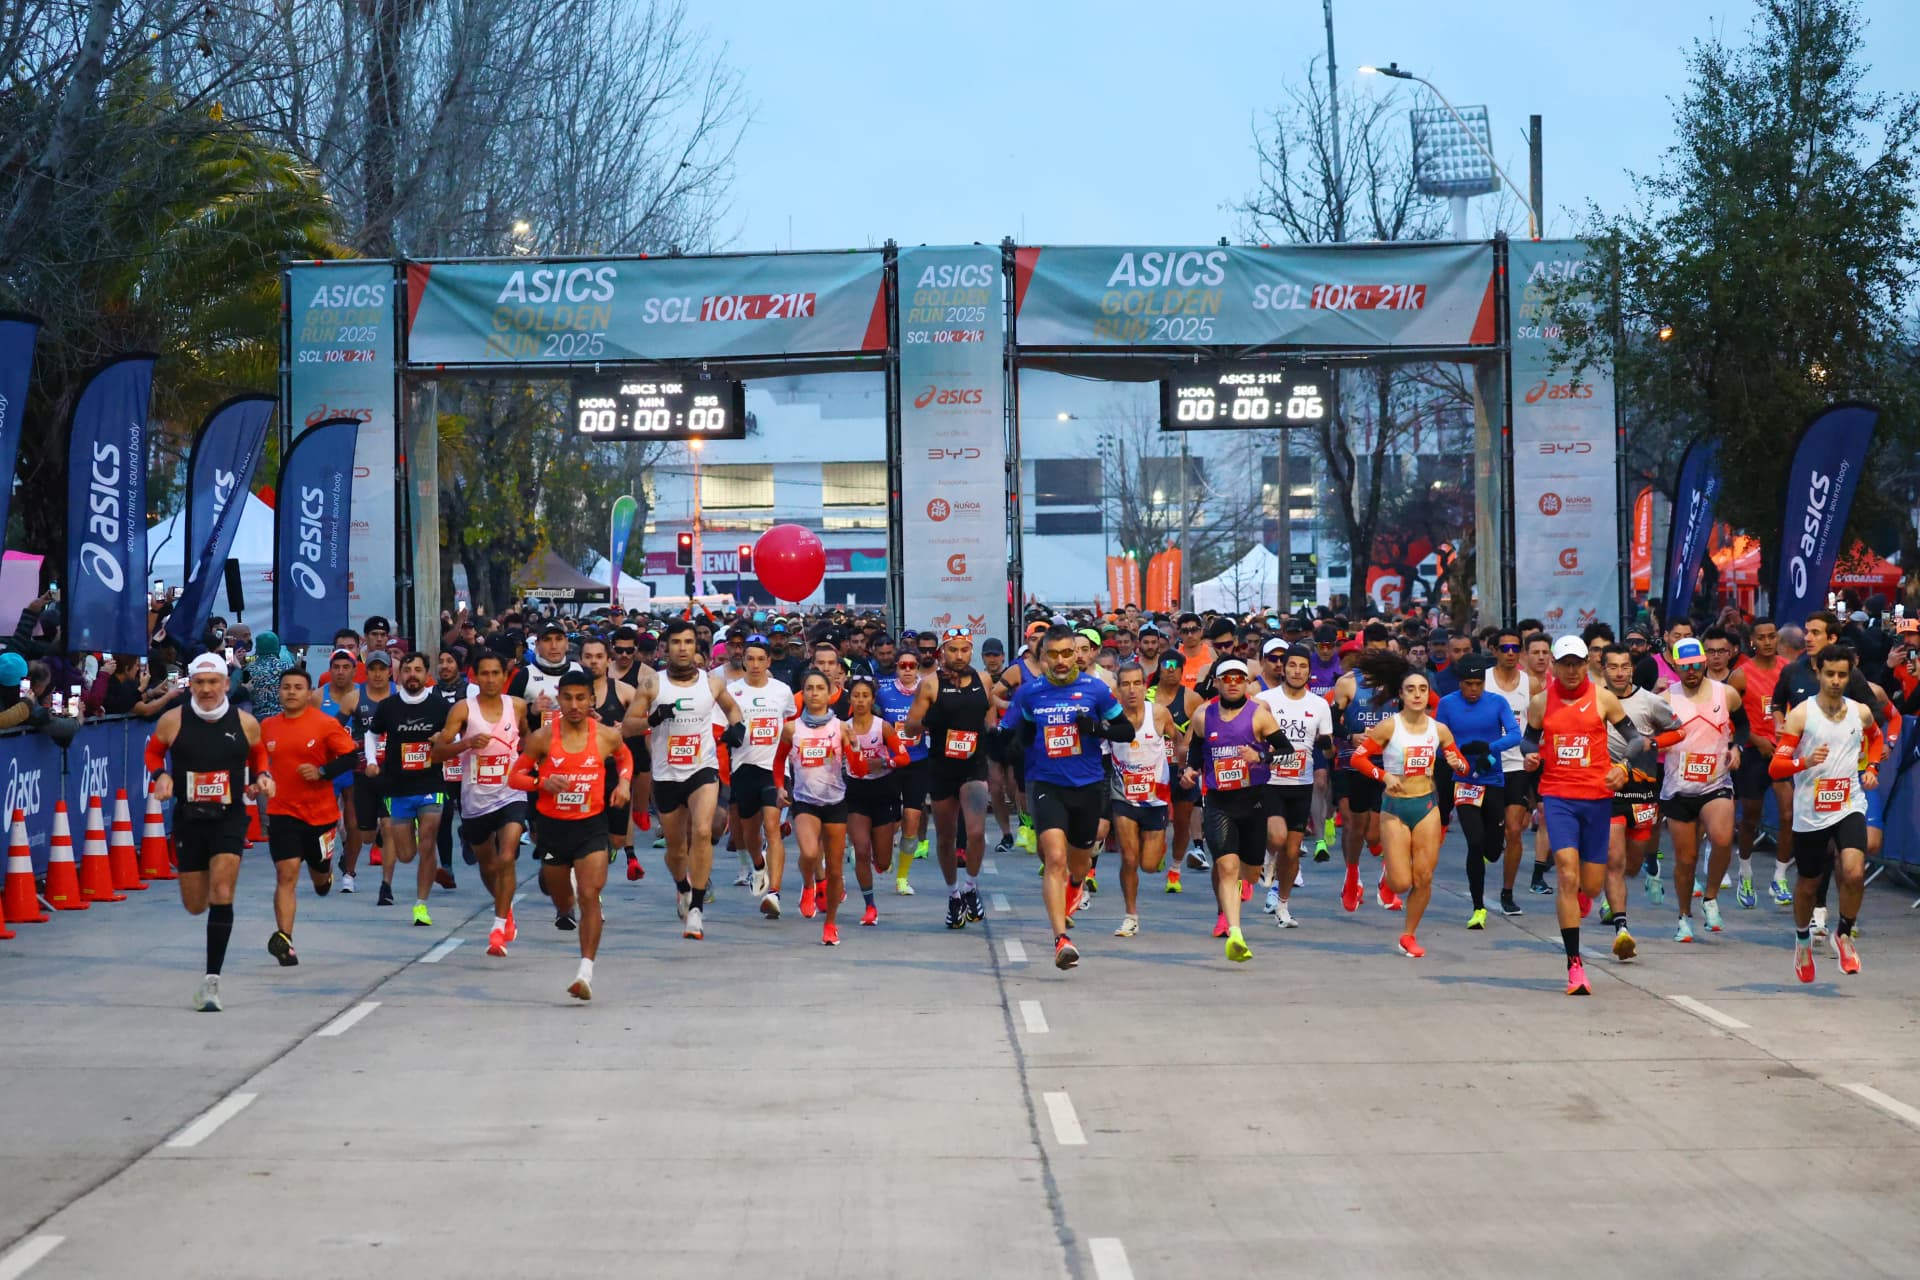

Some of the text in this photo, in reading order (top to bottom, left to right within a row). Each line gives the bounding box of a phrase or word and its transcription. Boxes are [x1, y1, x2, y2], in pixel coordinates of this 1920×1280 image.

[918, 264, 993, 288] ASICS
[1107, 252, 1227, 288] ASICS
[497, 267, 617, 303] ASICS
[310, 285, 385, 308] ASICS
[913, 289, 991, 306] GOLDEN
[1102, 289, 1223, 316] GOLDEN
[1253, 284, 1307, 312] SCL
[1312, 283, 1361, 311] 10k
[1374, 283, 1424, 310] 21k
[643, 298, 698, 326] SCL
[703, 296, 751, 322] 10k
[765, 293, 814, 319] 21k
[908, 306, 986, 324] RUN 2025
[305, 308, 382, 326] GOLDEN
[491, 304, 612, 332] GOLDEN
[337, 326, 377, 342] 2025
[1093, 316, 1215, 342] RUN 2025
[1517, 326, 1542, 339] SCL
[906, 330, 983, 344] SCL 10k 21k
[543, 333, 605, 357] 2025
[298, 350, 375, 363] SCL 10k 21k
[1219, 373, 1282, 385] ASICS 21K
[620, 384, 683, 395] ASICS 10K
[1178, 386, 1317, 398] HORA MIN SEG
[579, 396, 719, 409] HORA MIN SEG
[937, 389, 983, 405] asics
[129, 422, 141, 452] body
[928, 448, 981, 459] BYD
[1540, 443, 1592, 454] BYD
[129, 453, 138, 487] sound
[1838, 458, 1850, 484] body
[333, 471, 343, 493] body
[90, 440, 120, 543] asics
[1800, 469, 1830, 558] asics
[299, 485, 324, 562] asics
[127, 516, 135, 553] sound
[1047, 714, 1071, 724] CHILE
[1358, 712, 1379, 722] DEL
[757, 727, 771, 736] 610
[1063, 727, 1078, 735] 21k
[954, 741, 967, 750] 161
[1053, 737, 1070, 747] 601
[1573, 736, 1590, 747] 21k
[674, 746, 693, 755] 290
[806, 749, 824, 757] 669
[1562, 748, 1580, 757] 427
[1232, 759, 1247, 769] 21k
[1410, 758, 1427, 766] 862
[1690, 763, 1709, 773] 1533
[90, 756, 109, 798] asics
[1221, 770, 1241, 779] 1091
[199, 785, 223, 795] 1978
[575, 782, 592, 792] 21k
[1131, 784, 1147, 792] 143
[1834, 780, 1849, 790] 21k
[16, 769, 41, 816] asics
[560, 792, 584, 804] 1427
[1820, 790, 1843, 800] 1059
